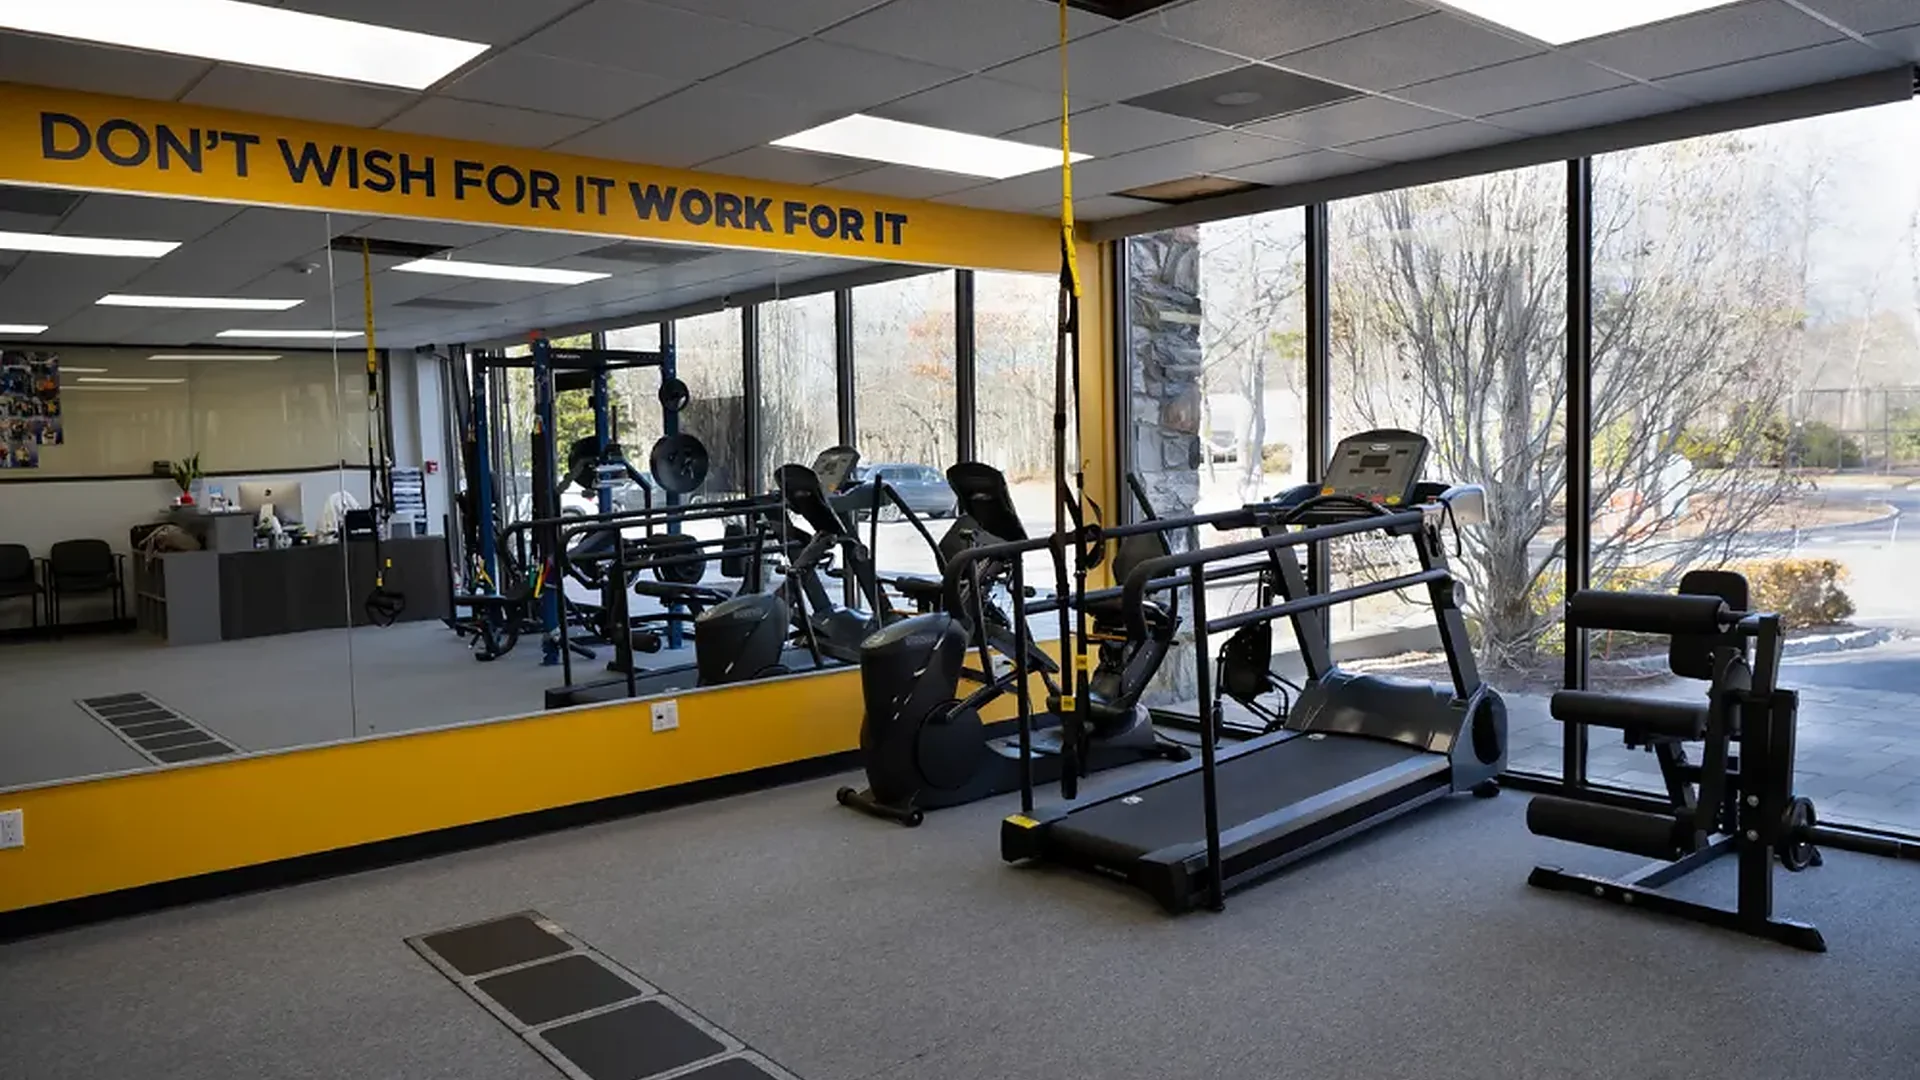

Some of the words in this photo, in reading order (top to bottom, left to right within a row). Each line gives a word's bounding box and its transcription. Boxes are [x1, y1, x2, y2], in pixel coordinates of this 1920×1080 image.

[40, 112, 260, 177] DON'T
[279, 140, 435, 197] WISH
[455, 160, 560, 211] FOR
[577, 176, 615, 216] IT
[630, 183, 773, 233] WORK
[785, 203, 865, 242] FOR
[875, 212, 908, 245] IT
